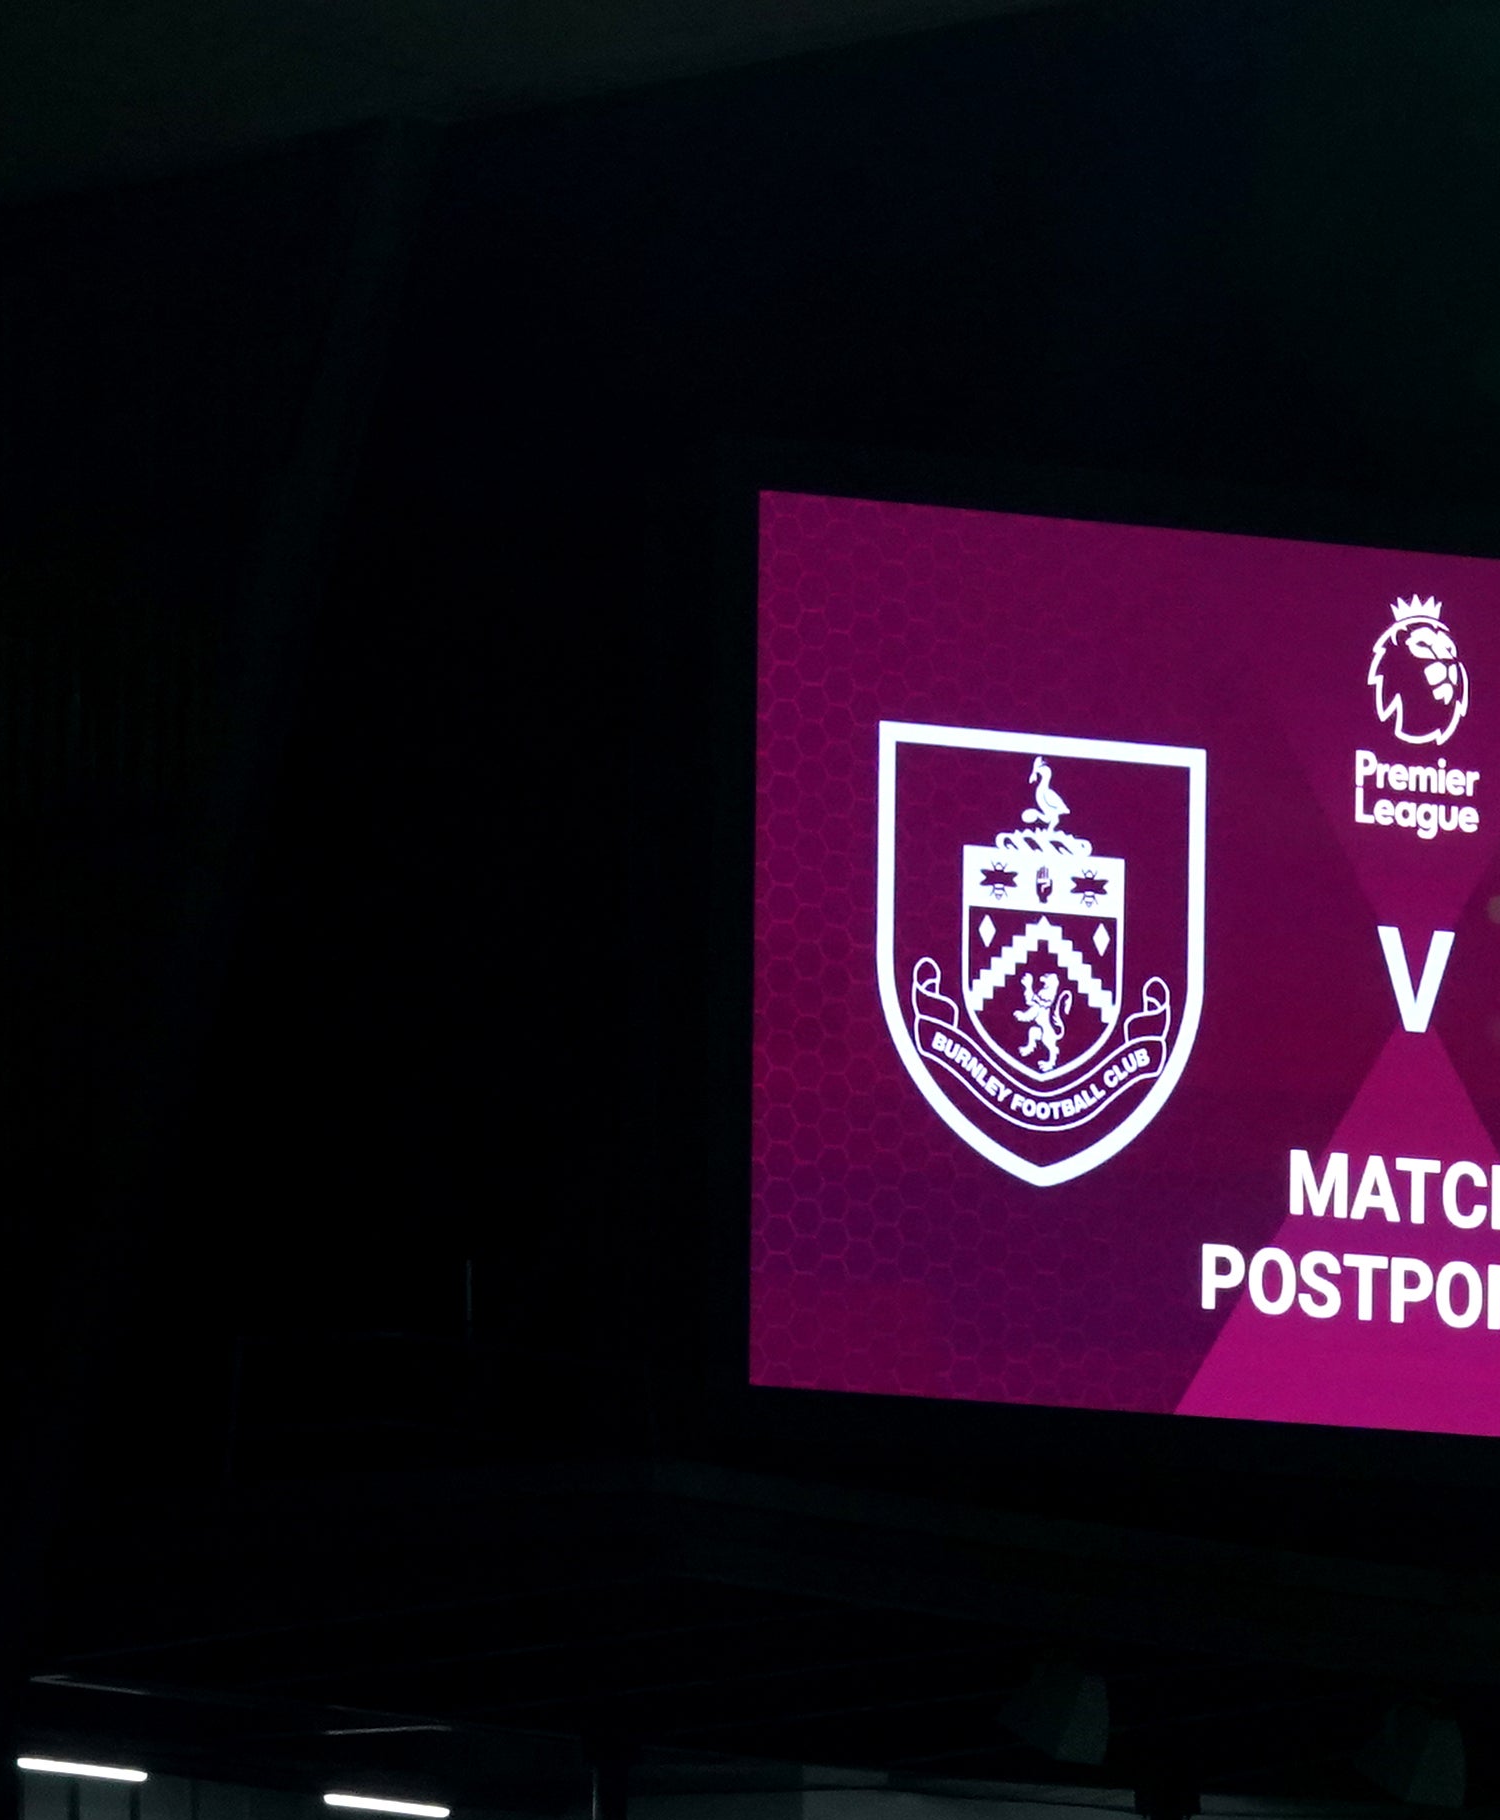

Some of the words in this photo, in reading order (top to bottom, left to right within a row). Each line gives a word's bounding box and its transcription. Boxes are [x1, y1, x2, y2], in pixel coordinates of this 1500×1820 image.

[1354, 749, 1481, 798] Premier
[1354, 786, 1481, 840] League
[1377, 925, 1456, 1033] V
[931, 1031, 1013, 1103] BURNLEY
[1010, 1083, 1107, 1121] FOOTBALL
[1103, 1047, 1151, 1088] CLUB
